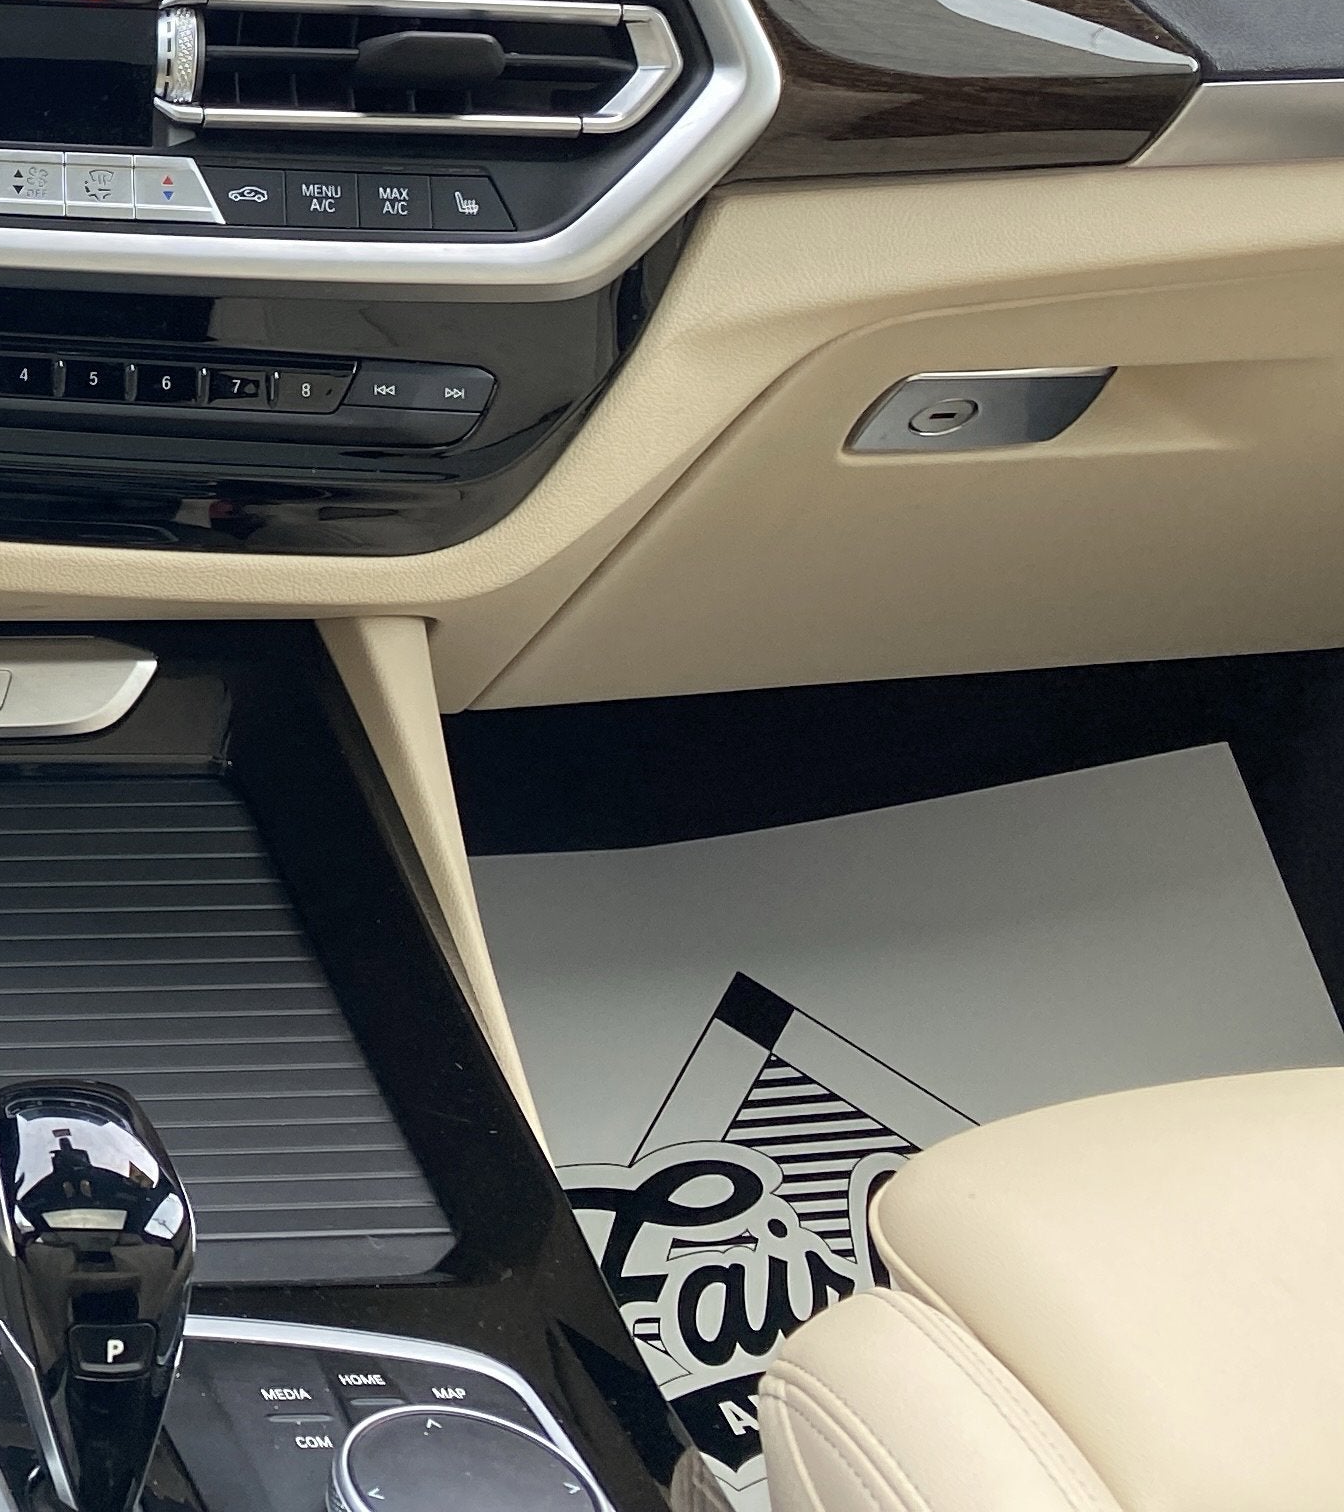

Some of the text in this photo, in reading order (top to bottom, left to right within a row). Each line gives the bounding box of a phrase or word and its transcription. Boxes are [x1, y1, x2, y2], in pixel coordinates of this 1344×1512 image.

[26, 188, 49, 200] OFF
[301, 183, 342, 199] MENU
[378, 186, 409, 202] MAX
[310, 197, 336, 214] A/C
[382, 200, 408, 216] A/C
[18, 366, 29, 383] 4
[88, 370, 98, 387] 5
[161, 374, 172, 391] 6
[231, 378, 242, 395] 7
[300, 382, 311, 399] 8
[105, 1338, 126, 1364] P
[337, 1373, 387, 1388] HOME
[259, 1386, 313, 1402] MEDIA
[431, 1386, 468, 1402] MAP
[294, 1435, 334, 1451] COM
